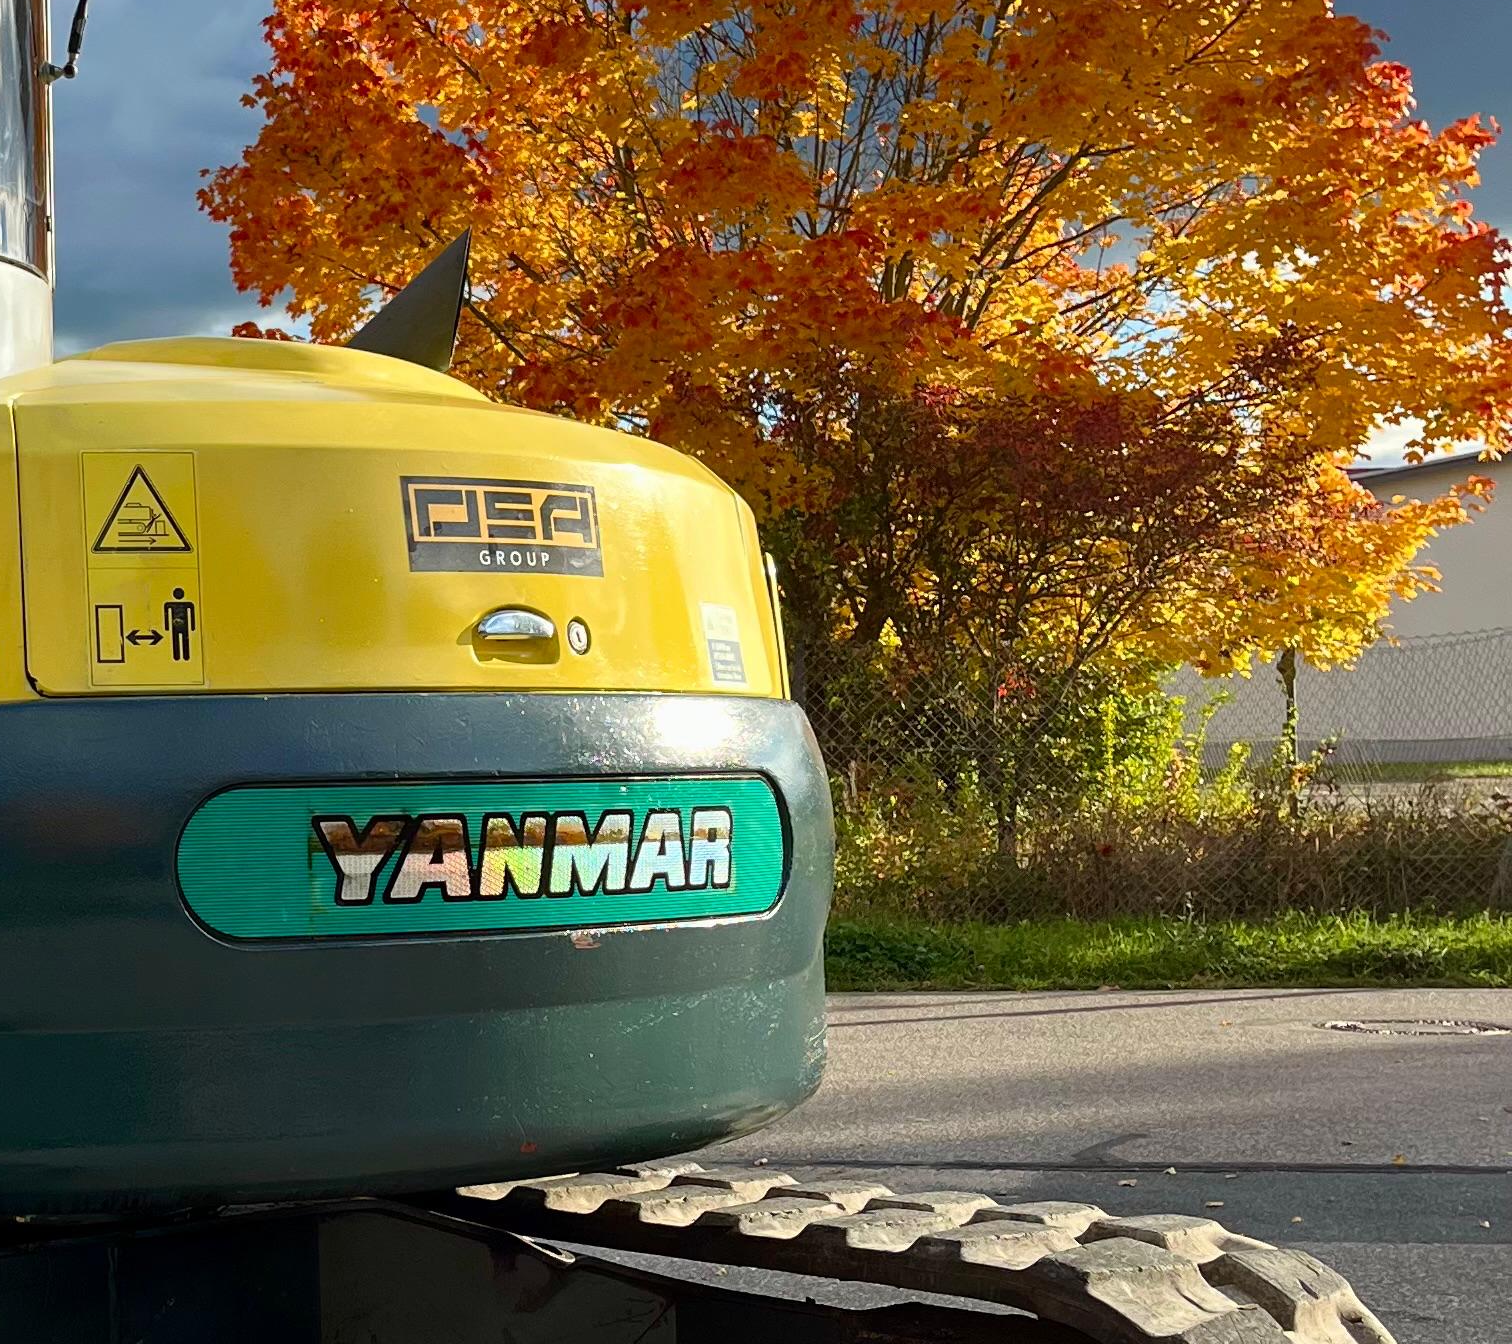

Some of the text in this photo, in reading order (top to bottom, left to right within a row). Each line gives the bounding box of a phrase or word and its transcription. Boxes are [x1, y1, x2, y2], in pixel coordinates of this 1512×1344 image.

[411, 486, 595, 546] PSA
[479, 549, 551, 568] GROUP
[311, 805, 734, 906] YANMAR
